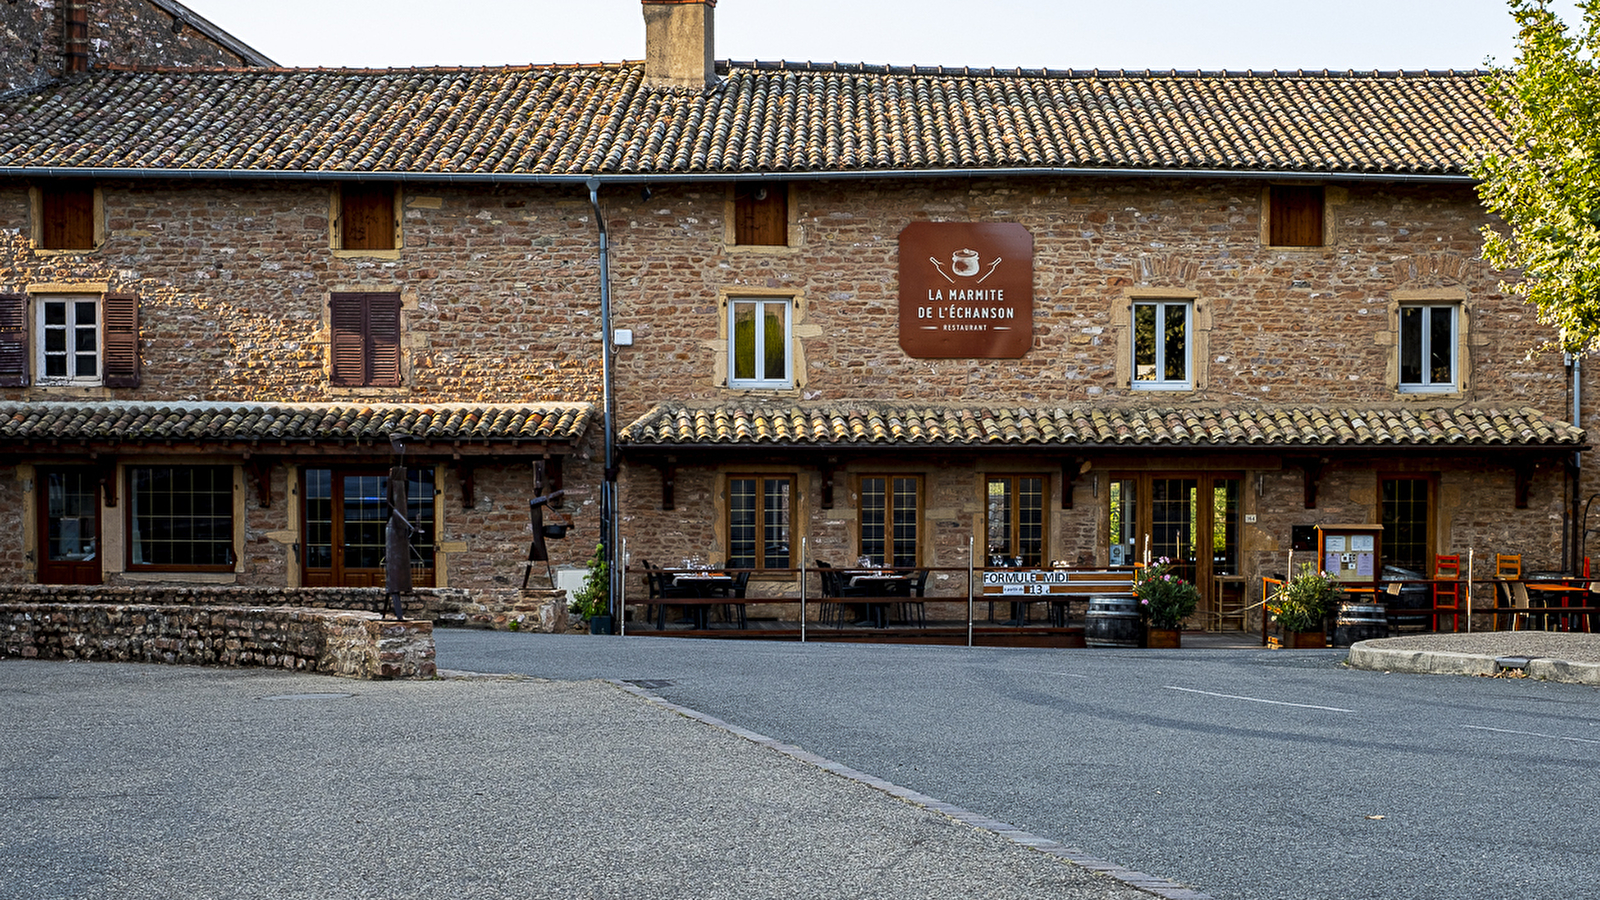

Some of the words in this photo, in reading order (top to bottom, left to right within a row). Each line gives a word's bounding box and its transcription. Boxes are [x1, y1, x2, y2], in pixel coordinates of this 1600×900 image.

[928, 289, 943, 301] LA
[949, 289, 1004, 301] MARMITE
[918, 307, 933, 319] DE
[938, 304, 1014, 319] L'ÉCHANSON
[984, 573, 1036, 583] FORMULE
[1043, 573, 1069, 582] MIDI
[1030, 585, 1043, 594] 13
